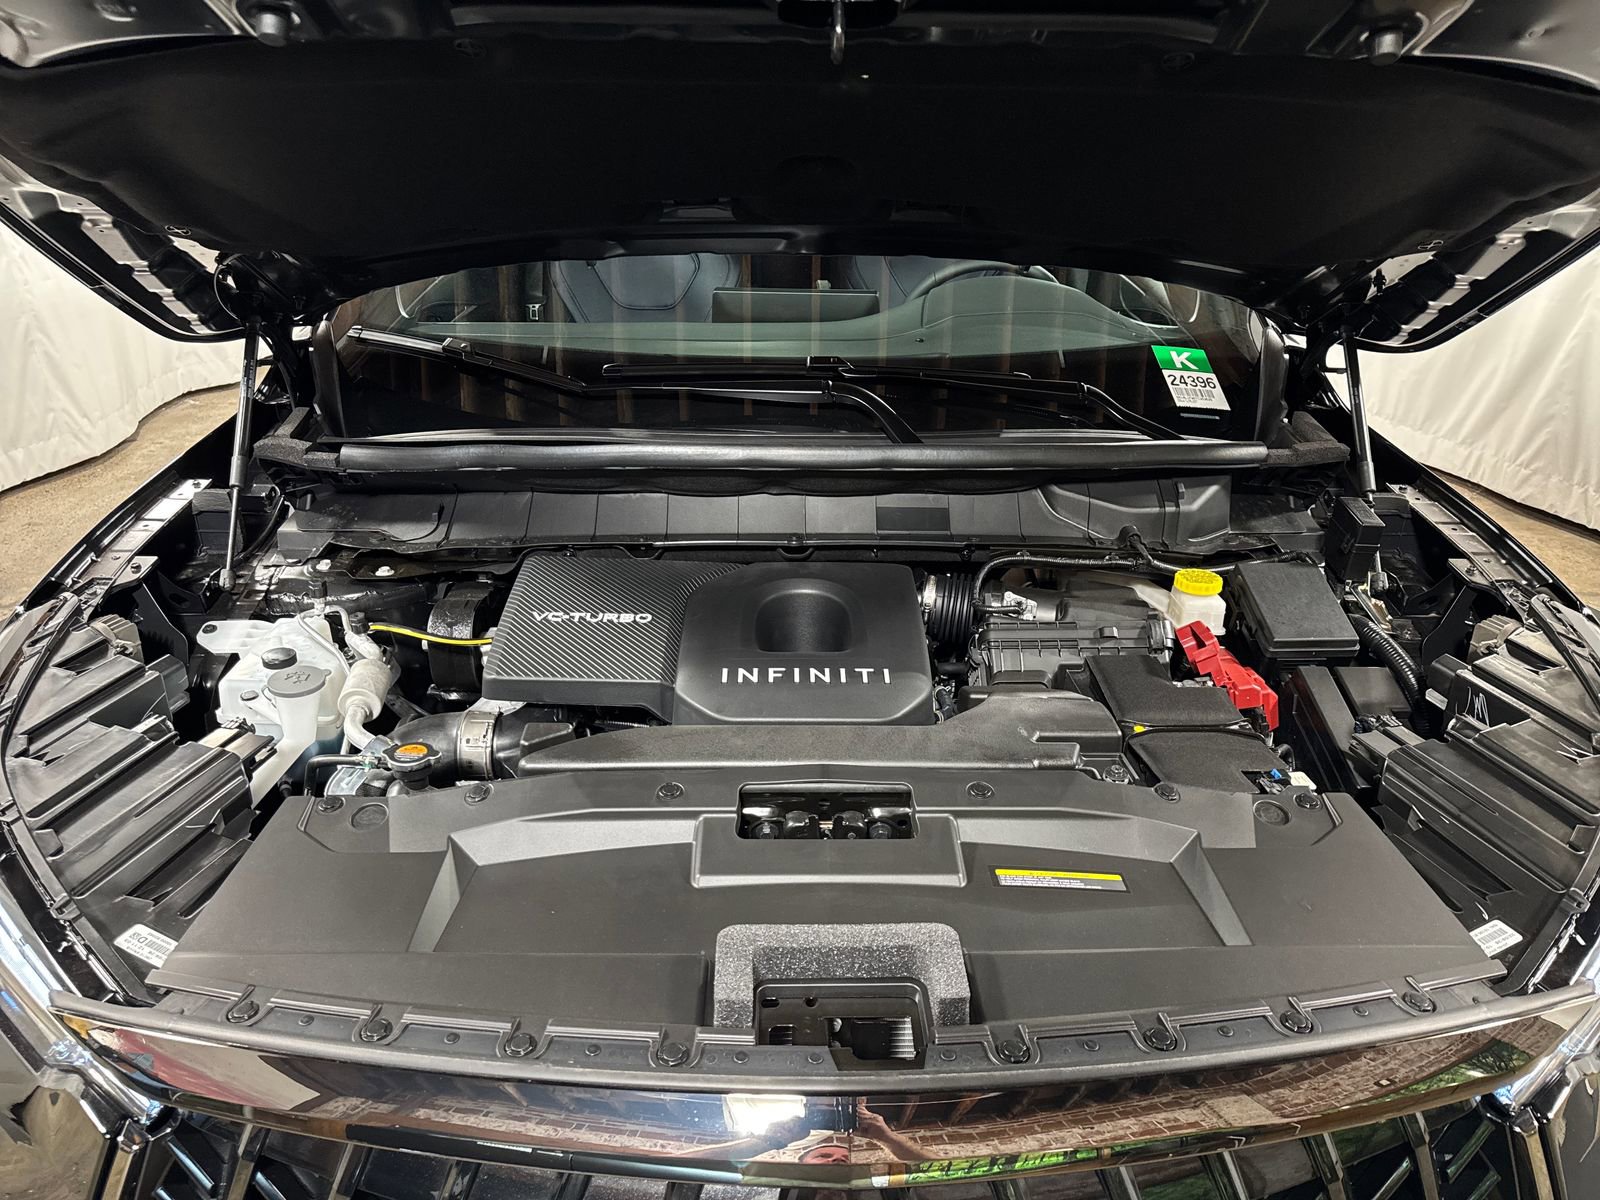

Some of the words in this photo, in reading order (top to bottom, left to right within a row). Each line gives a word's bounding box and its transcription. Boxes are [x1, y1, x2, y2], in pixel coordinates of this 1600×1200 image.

[1170, 351, 1198, 369] K
[1167, 374, 1216, 389] 24396
[532, 611, 653, 624] VC-TURBO
[721, 667, 891, 684] INFINITI
